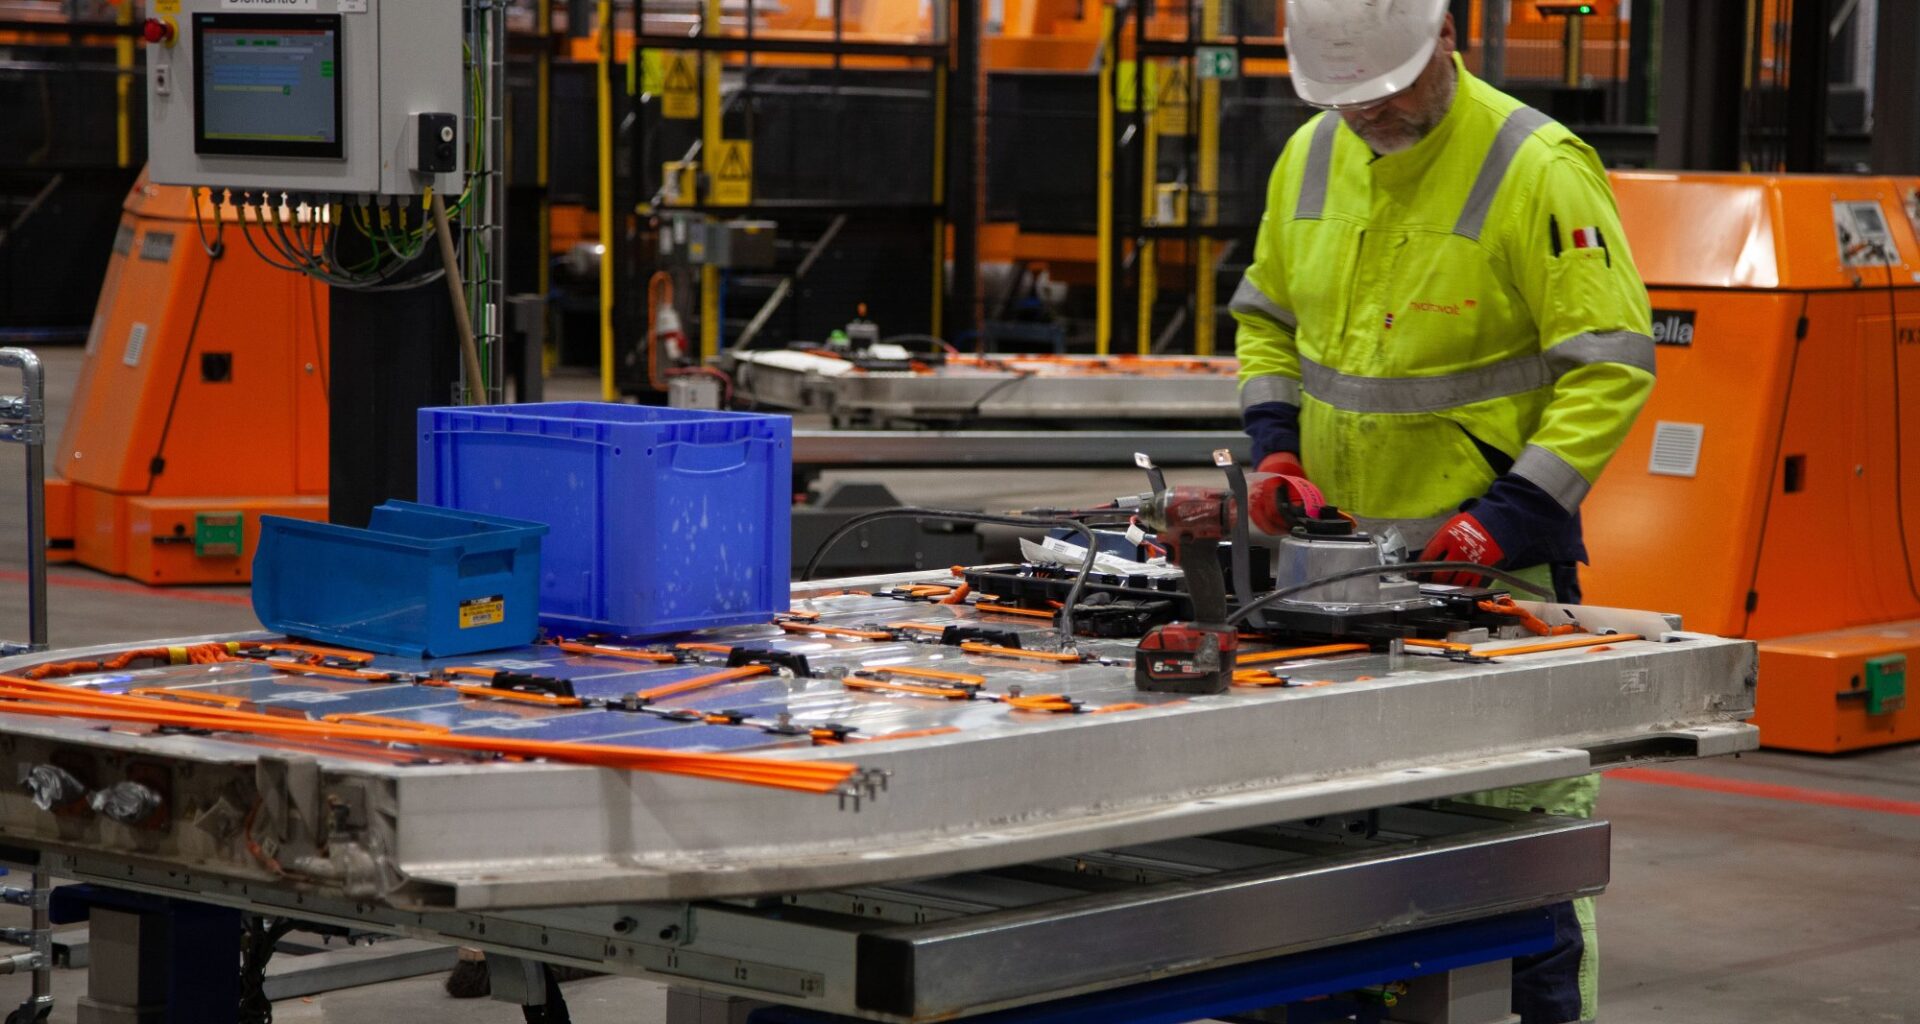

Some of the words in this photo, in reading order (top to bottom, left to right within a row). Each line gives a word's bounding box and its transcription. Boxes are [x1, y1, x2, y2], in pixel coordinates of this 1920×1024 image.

[478, 922, 486, 935] 8
[604, 944, 617, 957] 10
[667, 955, 679, 969] 11
[735, 966, 747, 980] 12
